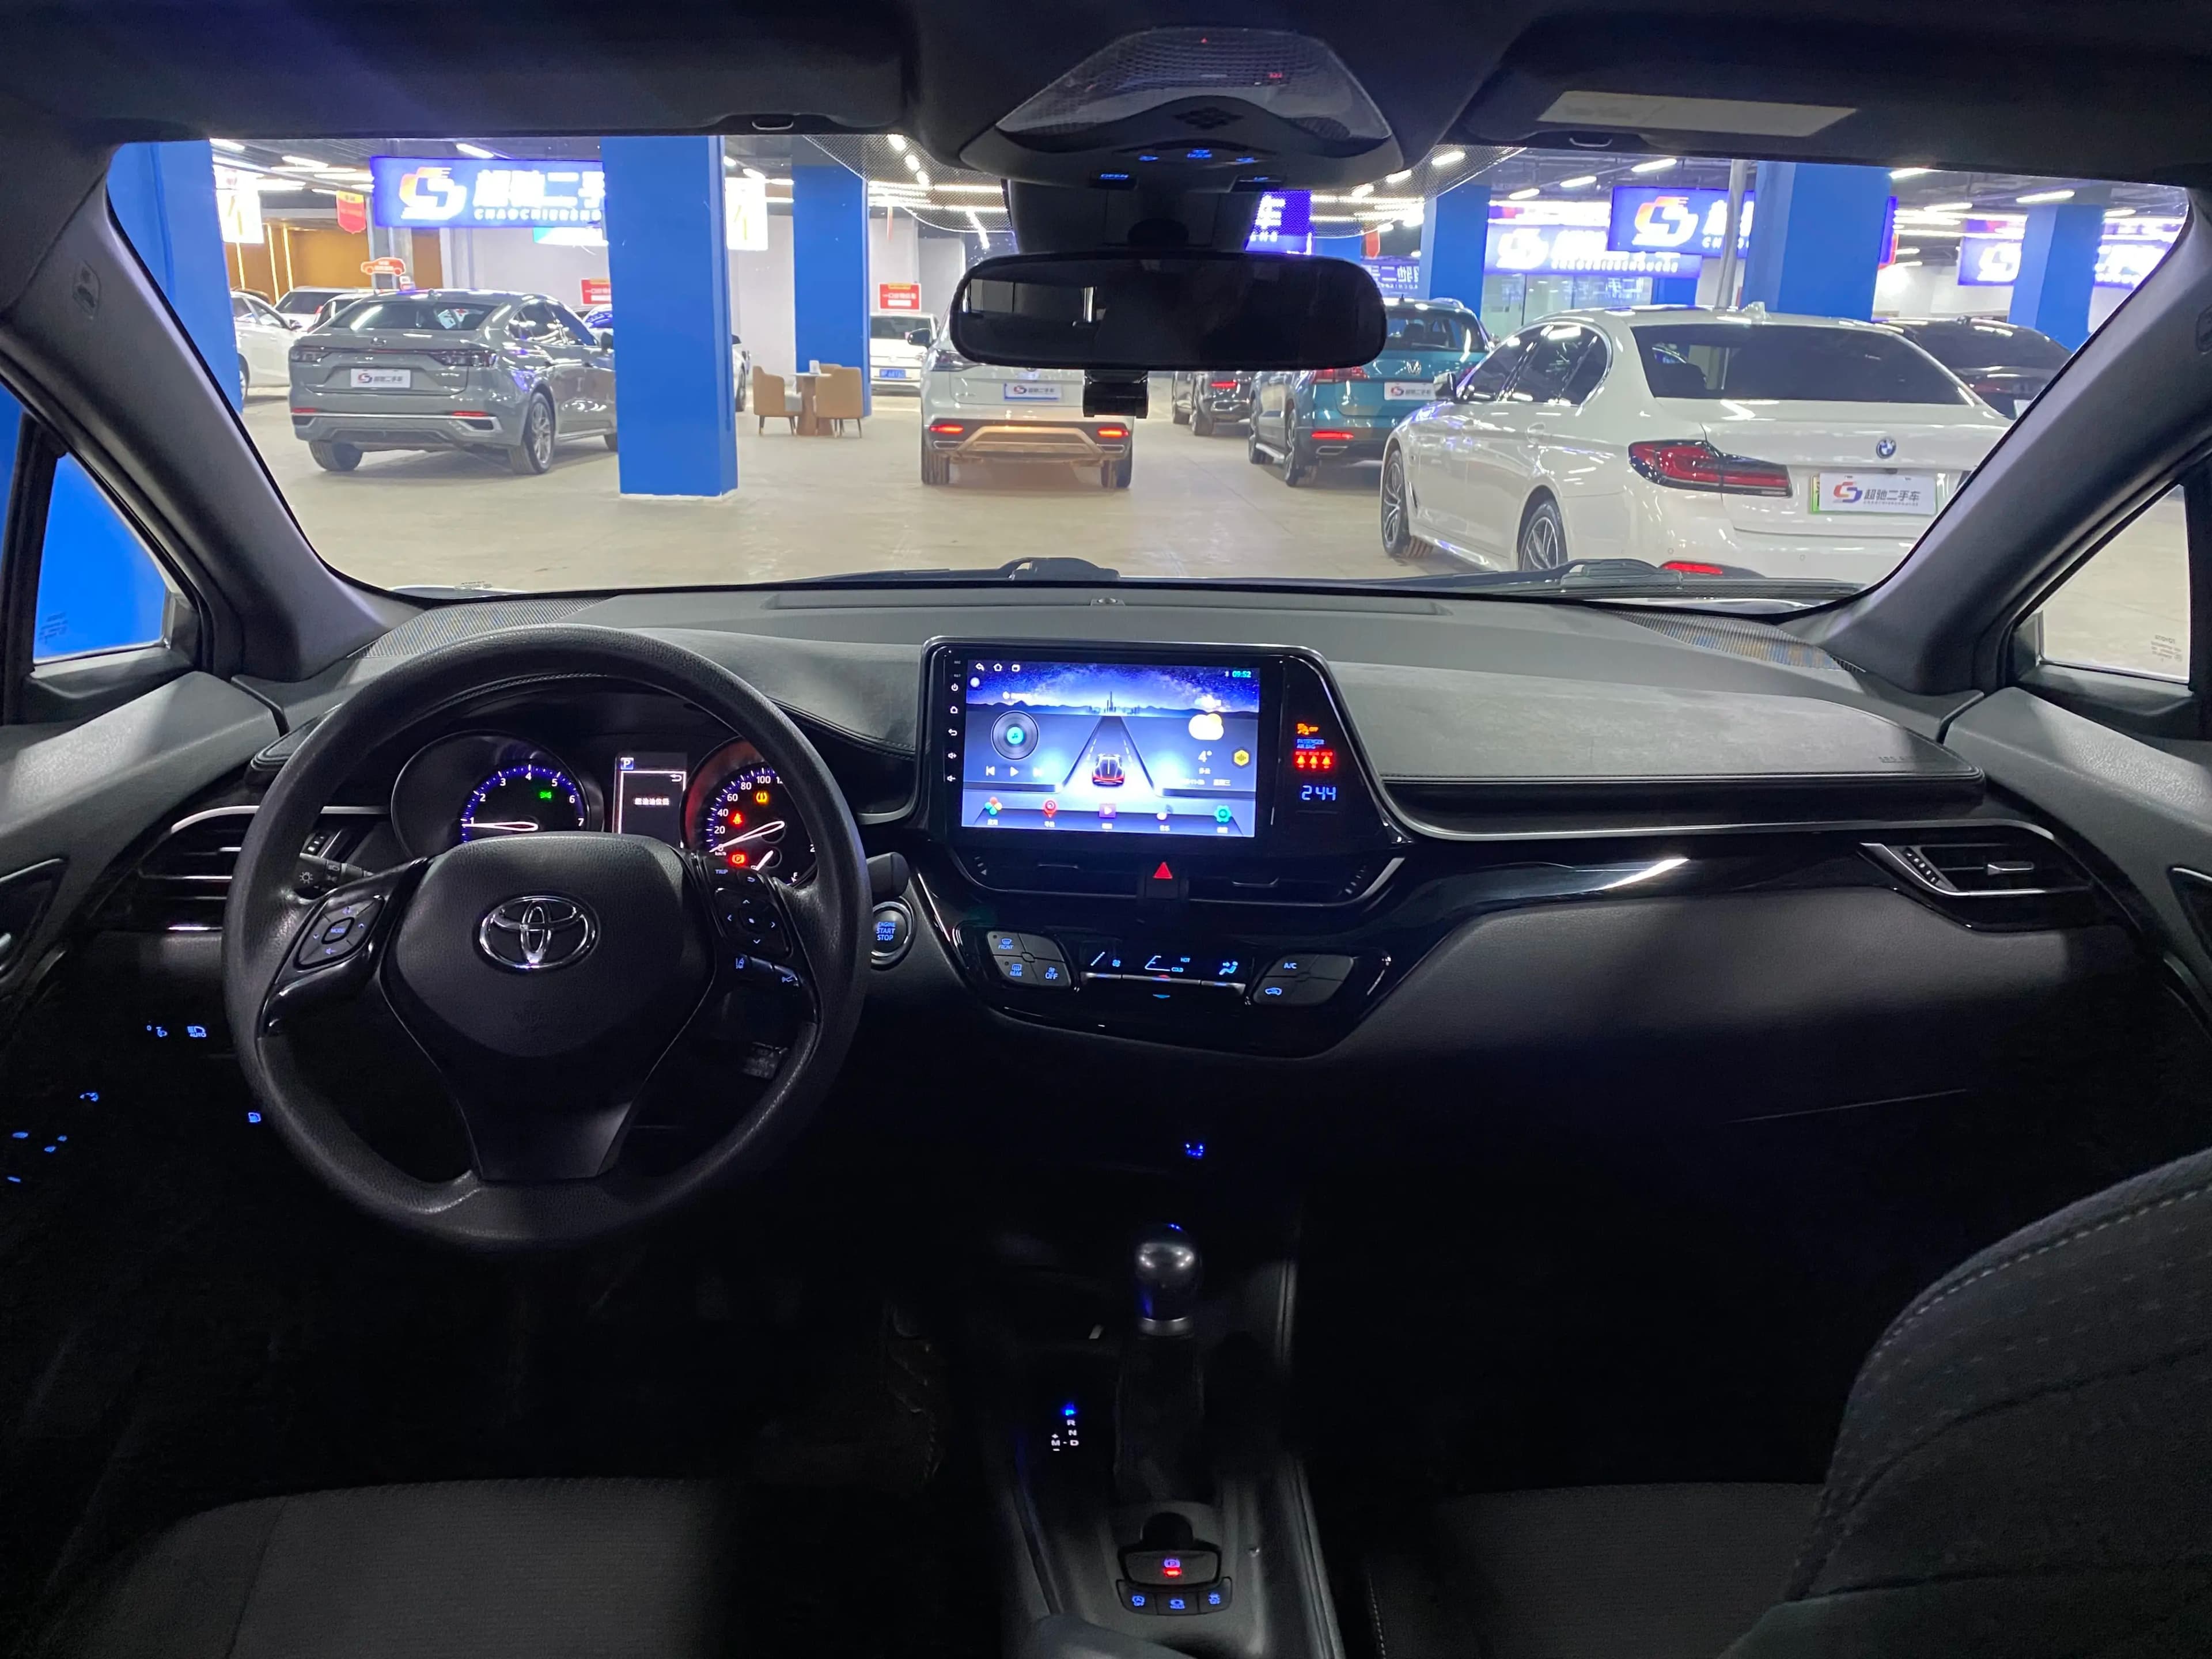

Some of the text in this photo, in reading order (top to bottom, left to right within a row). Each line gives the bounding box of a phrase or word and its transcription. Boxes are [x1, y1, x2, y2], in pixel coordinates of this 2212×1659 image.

[1864, 488, 1921, 502] 超驰二手车
[525, 772, 532, 781] 4
[757, 775, 771, 783] 100
[500, 778, 506, 786] 3
[551, 779, 558, 787] 5
[740, 782, 752, 790] 80
[479, 794, 486, 802] 2
[727, 793, 738, 802] 60
[717, 808, 729, 817] 40
[578, 818, 584, 826] 7
[714, 825, 726, 834] 20
